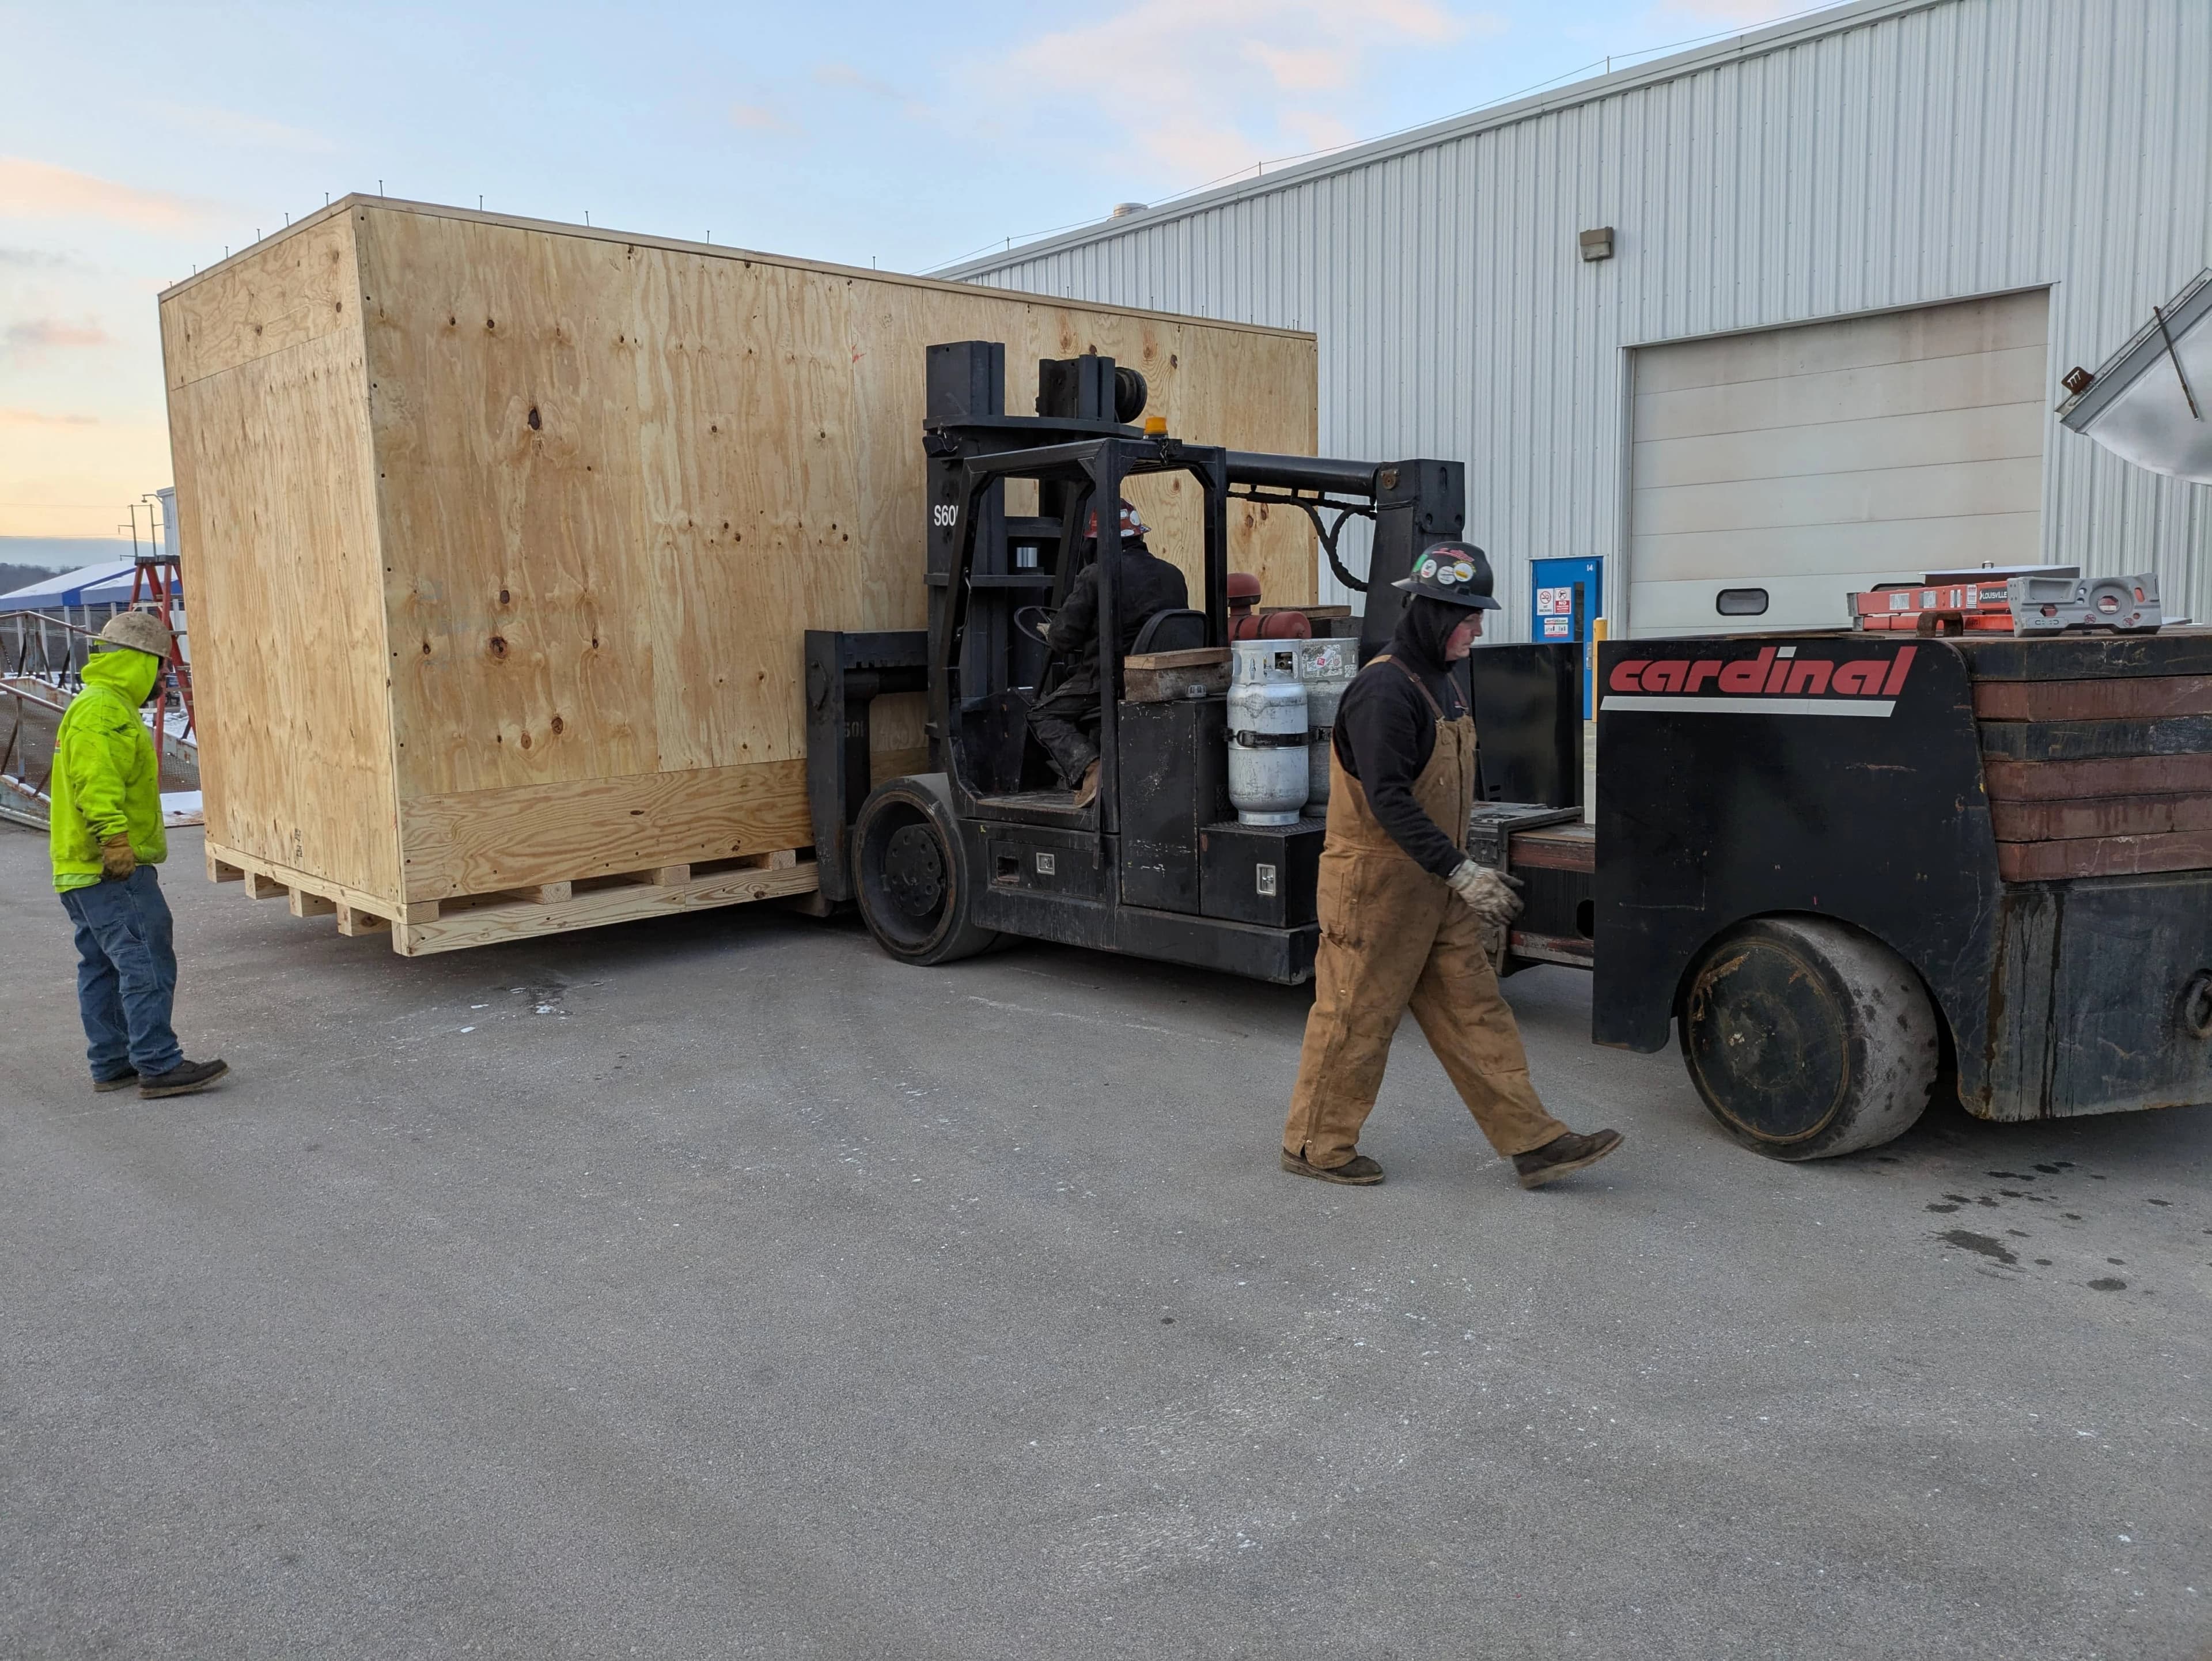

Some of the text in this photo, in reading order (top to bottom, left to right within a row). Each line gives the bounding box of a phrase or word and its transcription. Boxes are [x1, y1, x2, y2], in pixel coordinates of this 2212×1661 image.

[934, 505, 959, 527] S60
[1982, 591, 2008, 599] LOUISVILLE
[1609, 646, 1918, 695] cardinal
